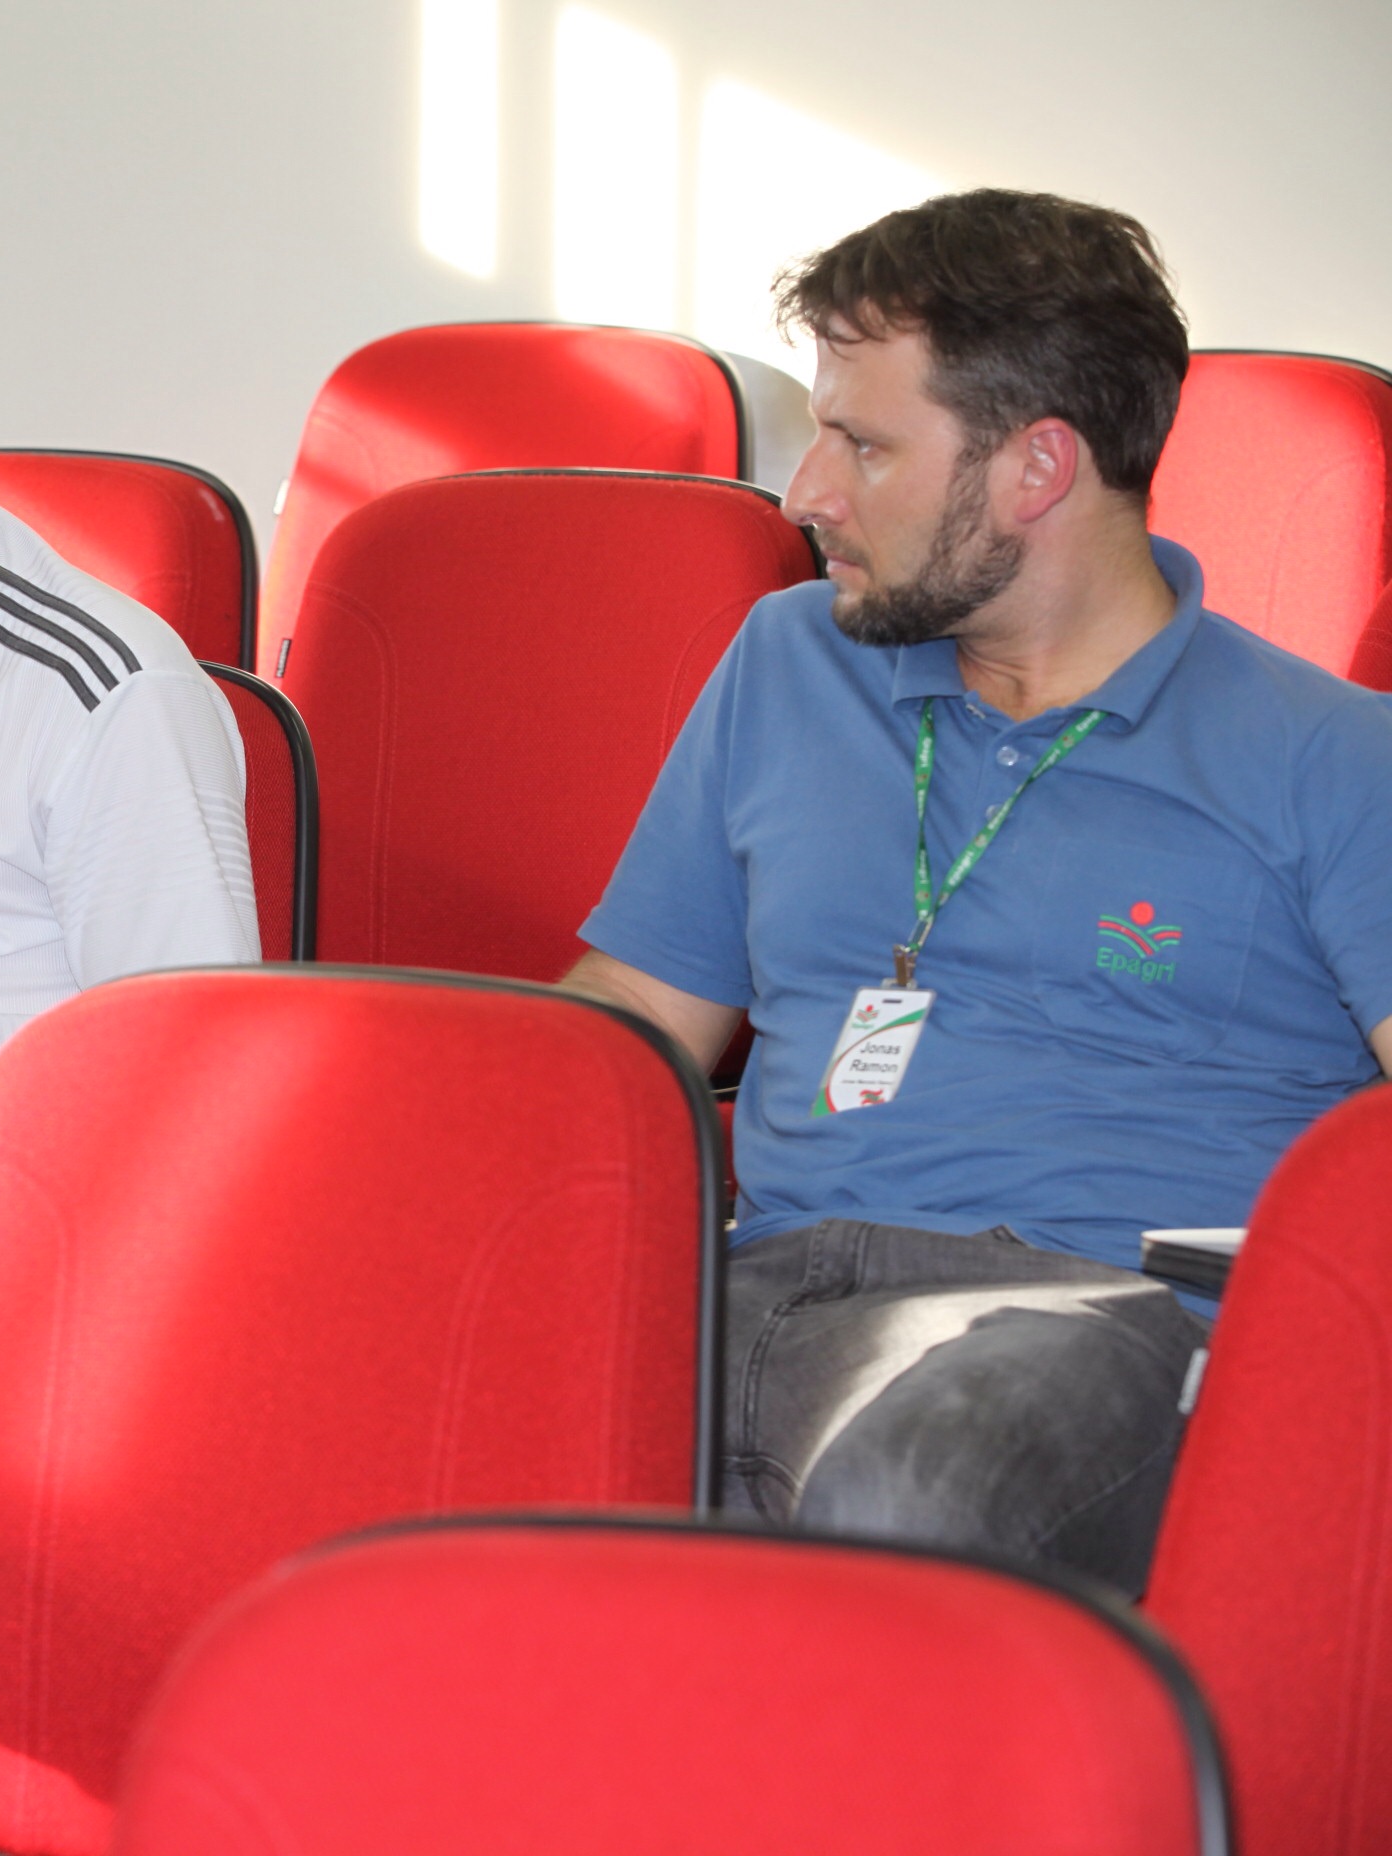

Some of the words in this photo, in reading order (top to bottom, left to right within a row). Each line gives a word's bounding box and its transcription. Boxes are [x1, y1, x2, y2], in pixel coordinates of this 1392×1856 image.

[1096, 947, 1176, 984] Epagri
[860, 1041, 901, 1055] Jonas
[849, 1059, 898, 1073] Ramon
